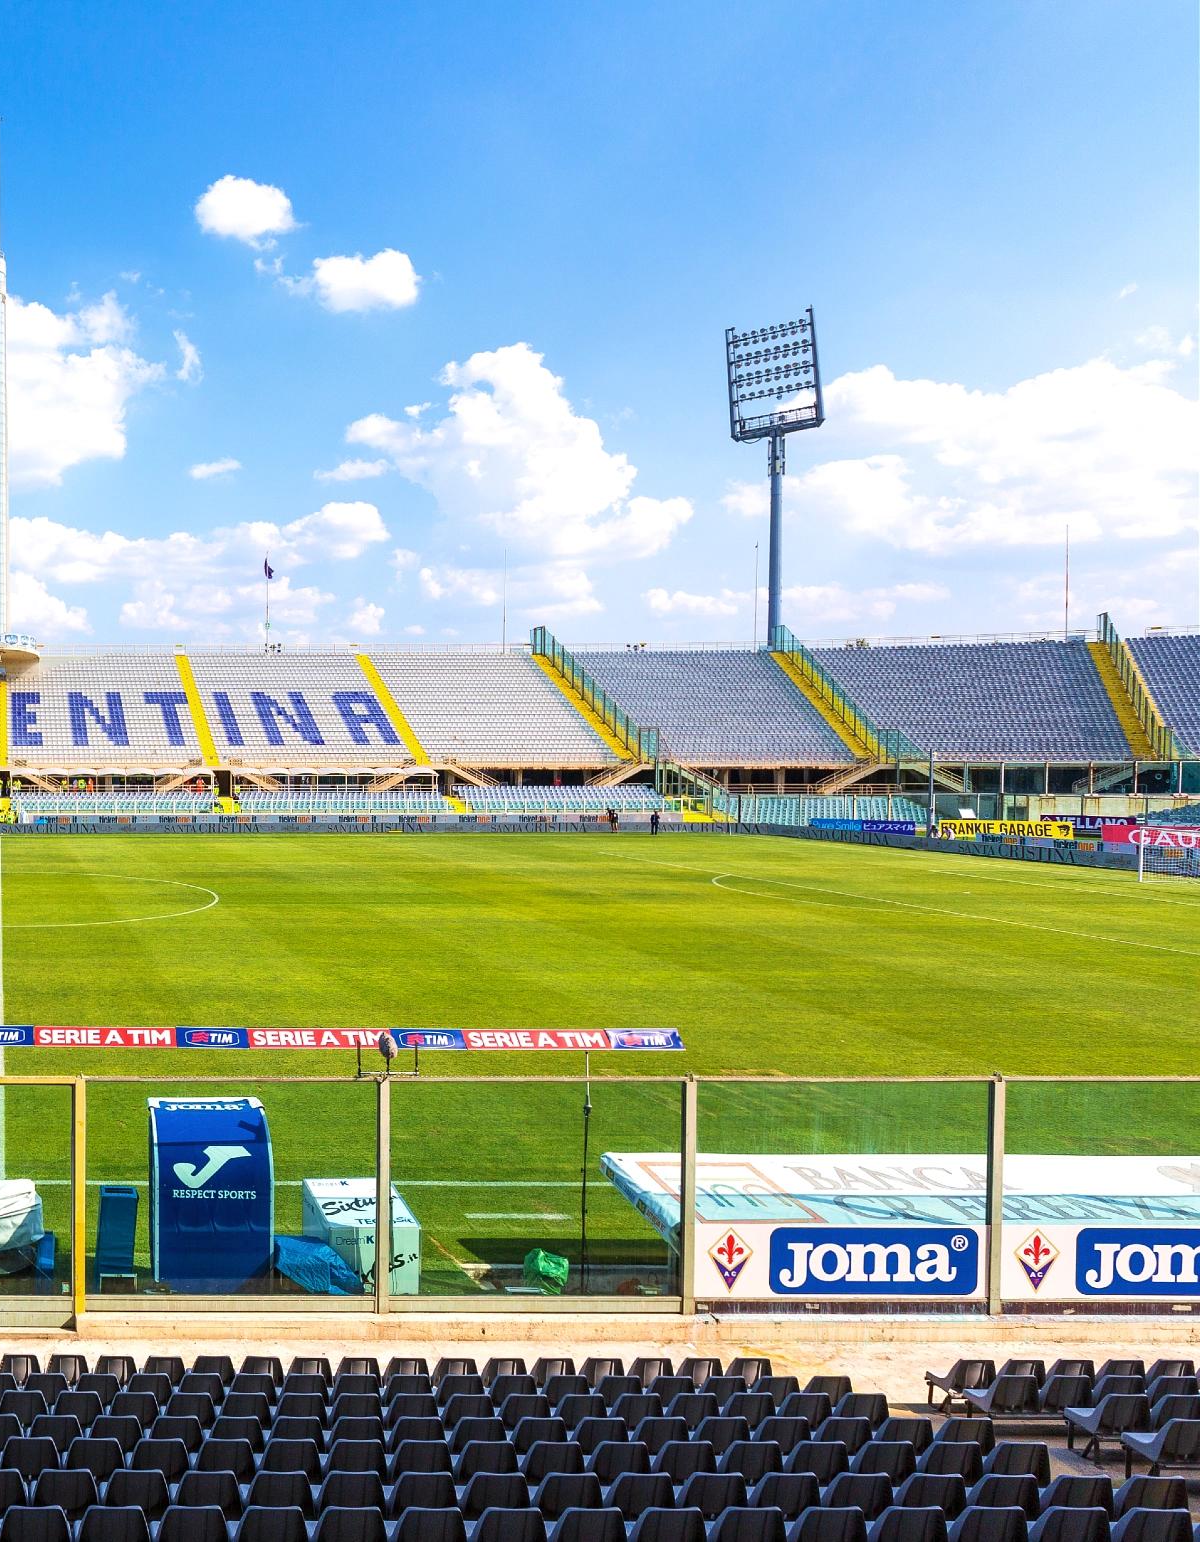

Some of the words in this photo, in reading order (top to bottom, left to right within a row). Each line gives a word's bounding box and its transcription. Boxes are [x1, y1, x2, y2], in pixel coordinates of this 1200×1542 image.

[2, 825, 33, 834] SANTA
[36, 824, 97, 834] CRISTINA
[164, 824, 196, 832] SANTA
[198, 823, 260, 833] CRISTINA
[328, 824, 358, 832] SANTA
[361, 823, 423, 832] CRISTINA
[490, 824, 521, 832] SANTA
[524, 823, 587, 832] CRISTINA
[690, 822, 760, 834] CRISTINA
[863, 823, 915, 831] ピュアスマイル
[1000, 823, 1053, 837] GARAGE
[800, 828, 830, 838] SANTA
[832, 830, 889, 845] CRISTINA
[959, 844, 996, 856] SANTA
[998, 844, 1074, 864] CRISTINA
[38, 1029, 100, 1044] SERIE
[104, 1030, 124, 1044] A
[127, 1030, 171, 1044] TIM
[209, 1033, 233, 1044] TIM
[253, 1030, 316, 1046] SERIE
[320, 1031, 340, 1046] A
[341, 1031, 382, 1047] TIM
[425, 1034, 449, 1046] TIM
[468, 1032, 535, 1048] SERIE
[538, 1032, 558, 1048] A
[560, 1032, 606, 1048] TIM
[642, 1034, 668, 1047] TIM
[783, 1166, 1023, 1190] BANCA
[173, 1190, 216, 1198] RESPECT
[218, 1190, 256, 1200] SPORTS
